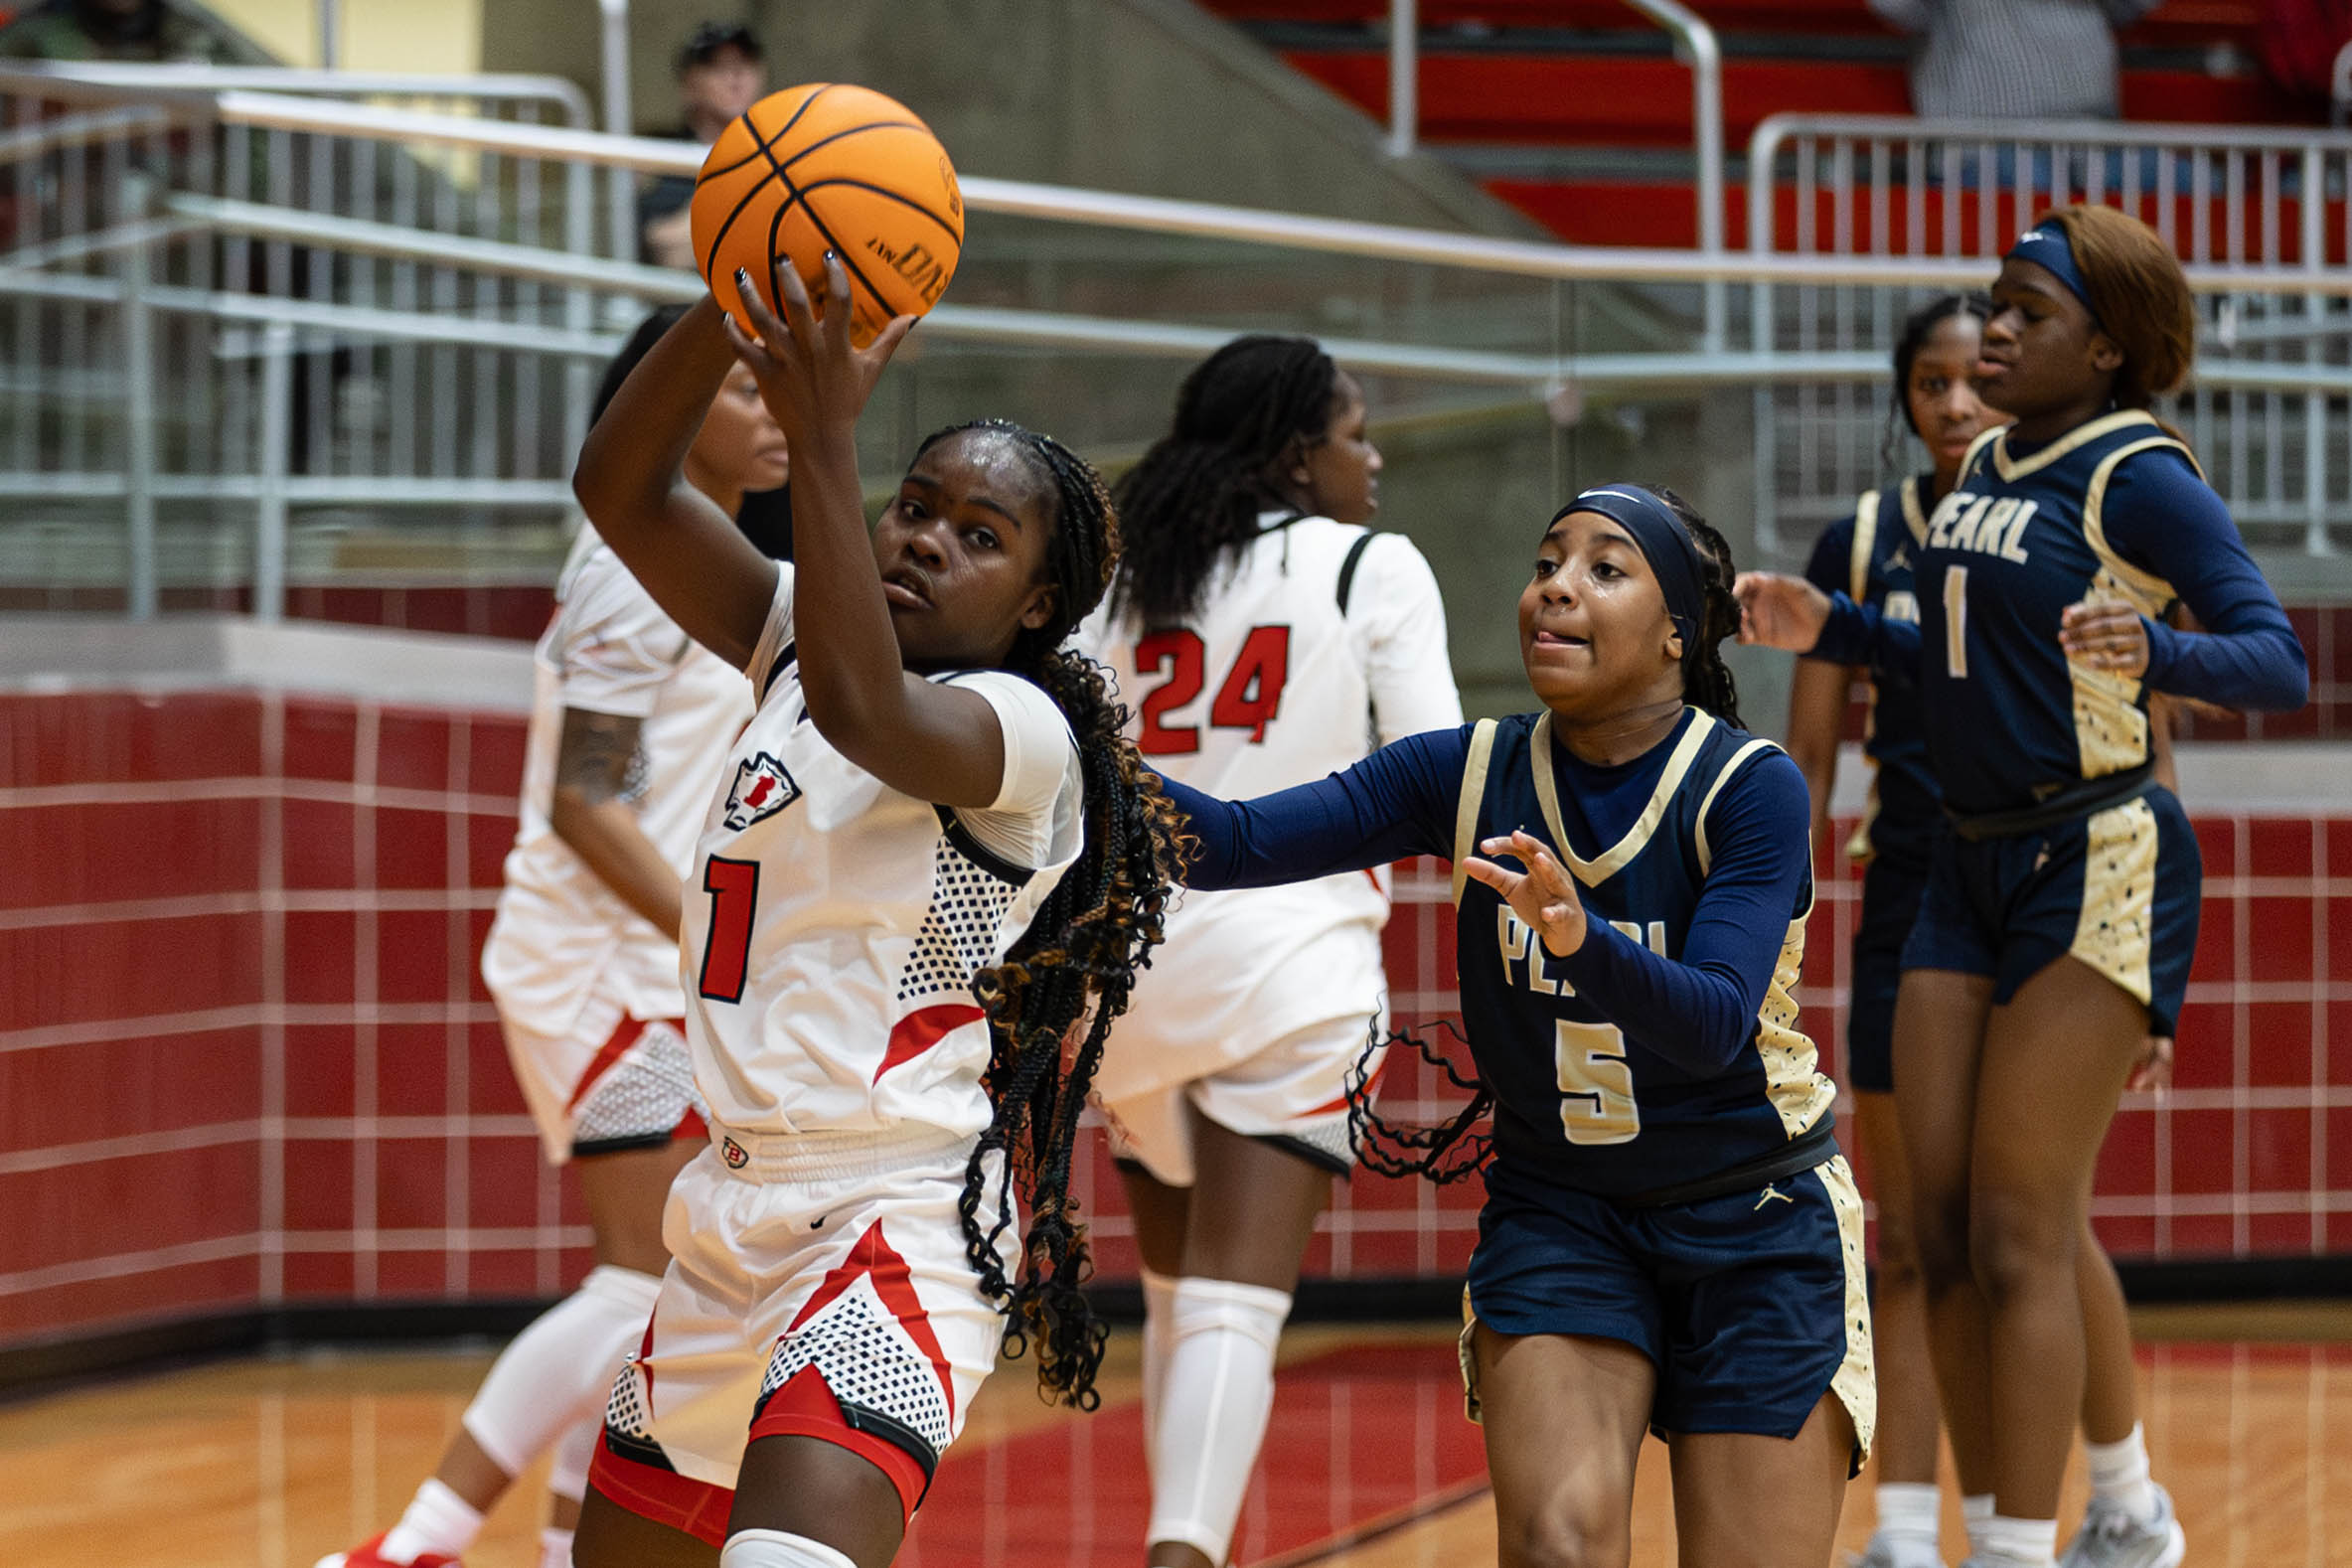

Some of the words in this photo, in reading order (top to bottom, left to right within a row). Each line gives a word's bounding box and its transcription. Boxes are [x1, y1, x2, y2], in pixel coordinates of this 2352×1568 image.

[1923, 491, 2039, 565] PEARL
[1943, 564, 1968, 679] 1
[1135, 624, 1291, 755] 24
[699, 853, 760, 1006] 1
[1555, 1018, 1641, 1146] 5
